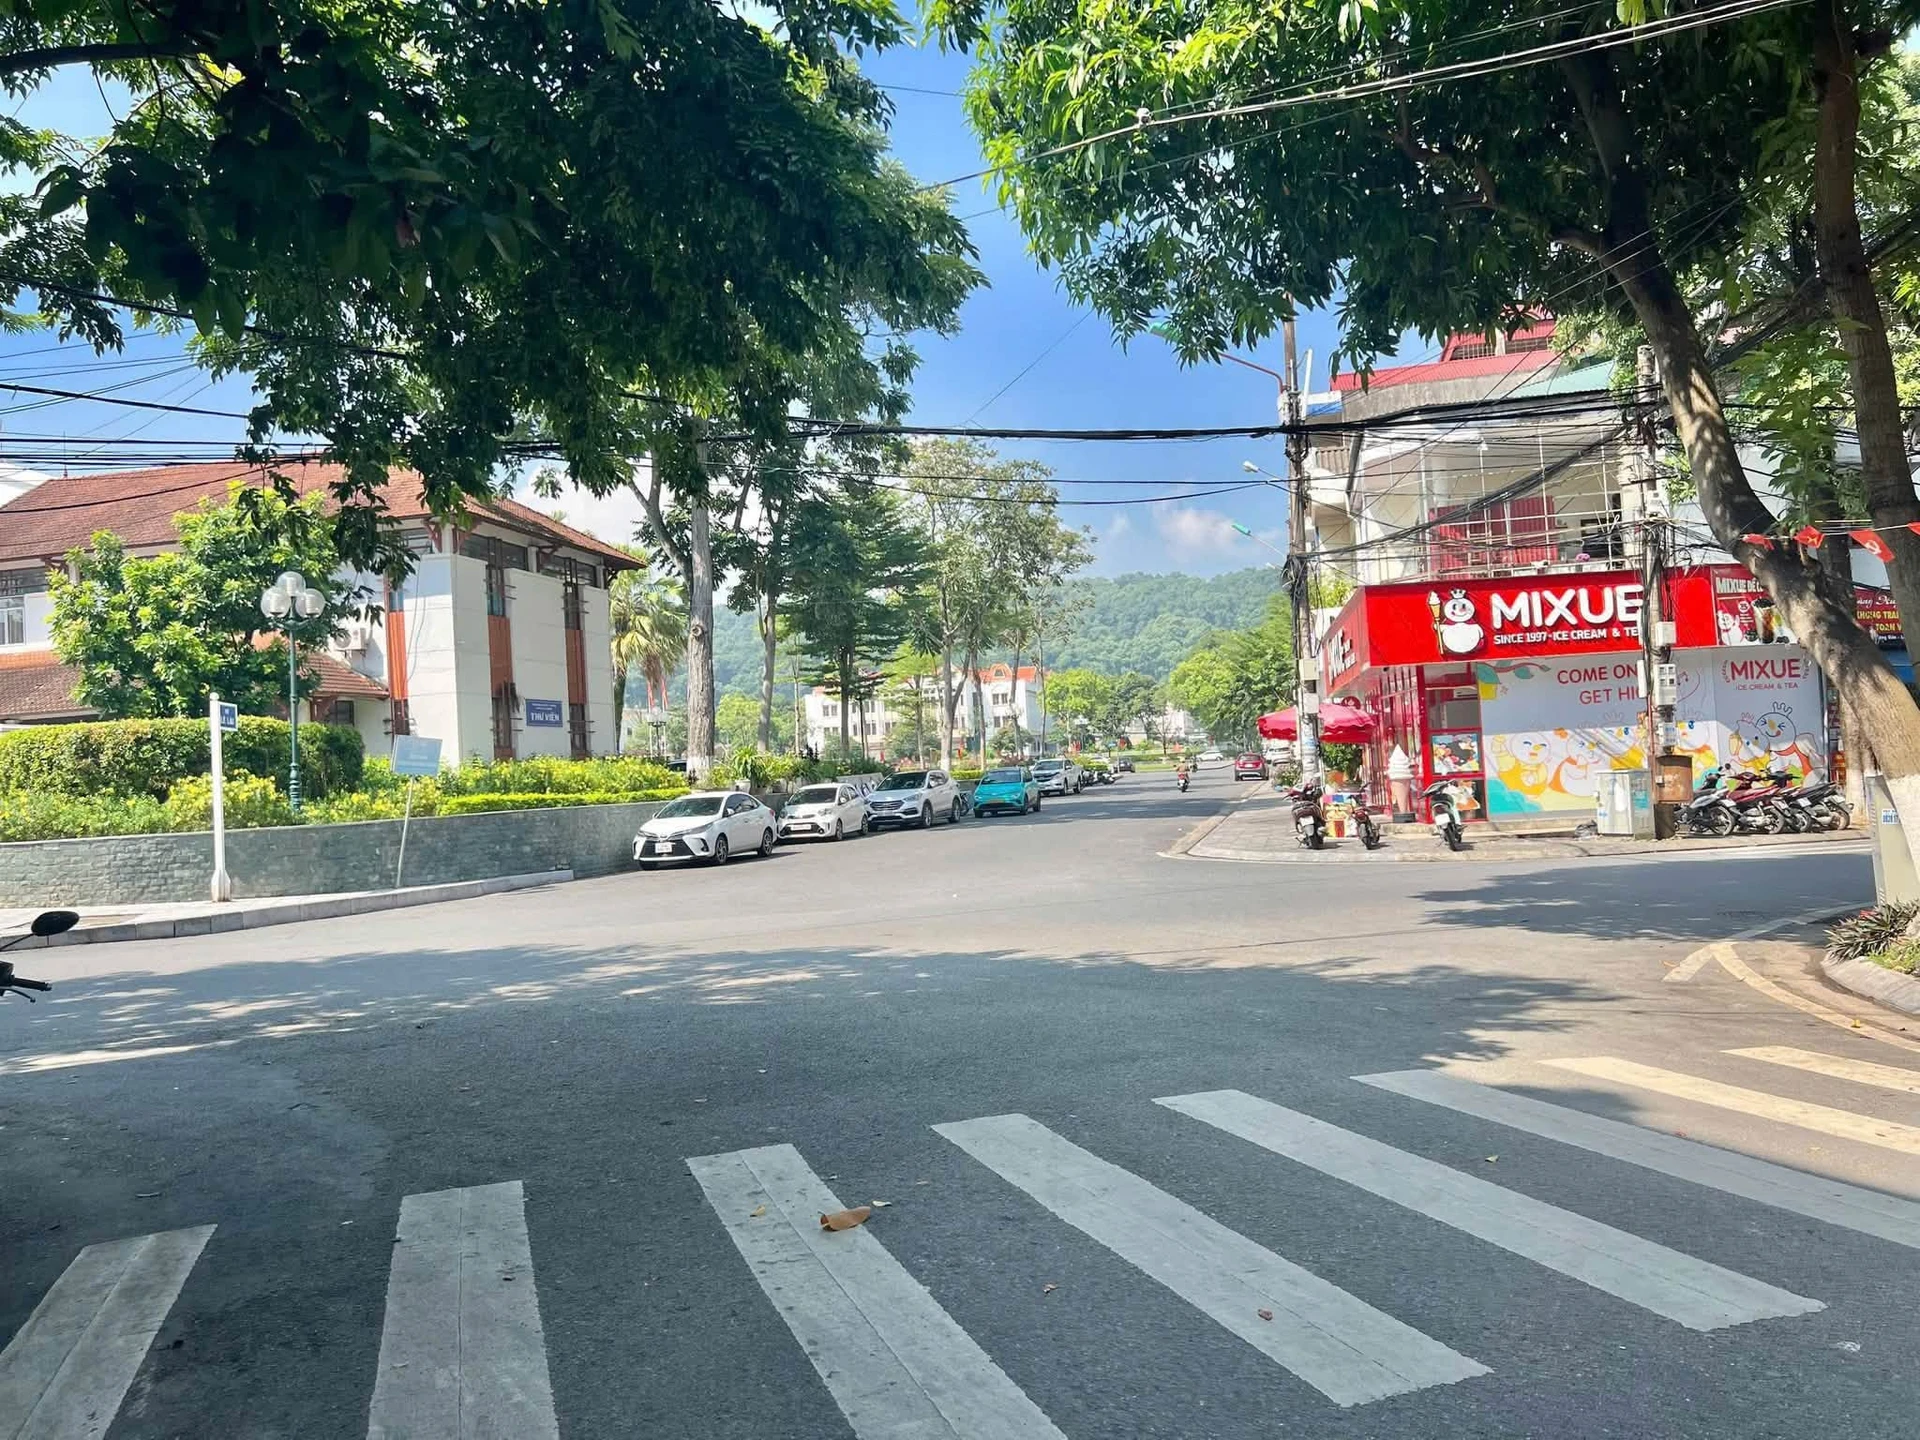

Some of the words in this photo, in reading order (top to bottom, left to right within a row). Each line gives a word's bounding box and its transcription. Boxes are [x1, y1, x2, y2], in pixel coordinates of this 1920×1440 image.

[1716, 577, 1746, 593] MIXUE
[1490, 584, 1643, 629] MIXUE
[1493, 634, 1523, 645] SINCE
[1571, 628, 1607, 640] CREAM
[1612, 628, 1620, 637] &
[1624, 627, 1639, 637] TE
[1557, 666, 1609, 684] COME
[1613, 663, 1638, 679] ON
[1730, 658, 1801, 681] MIXUE
[1736, 683, 1747, 691] ICE
[1579, 688, 1612, 705] GET
